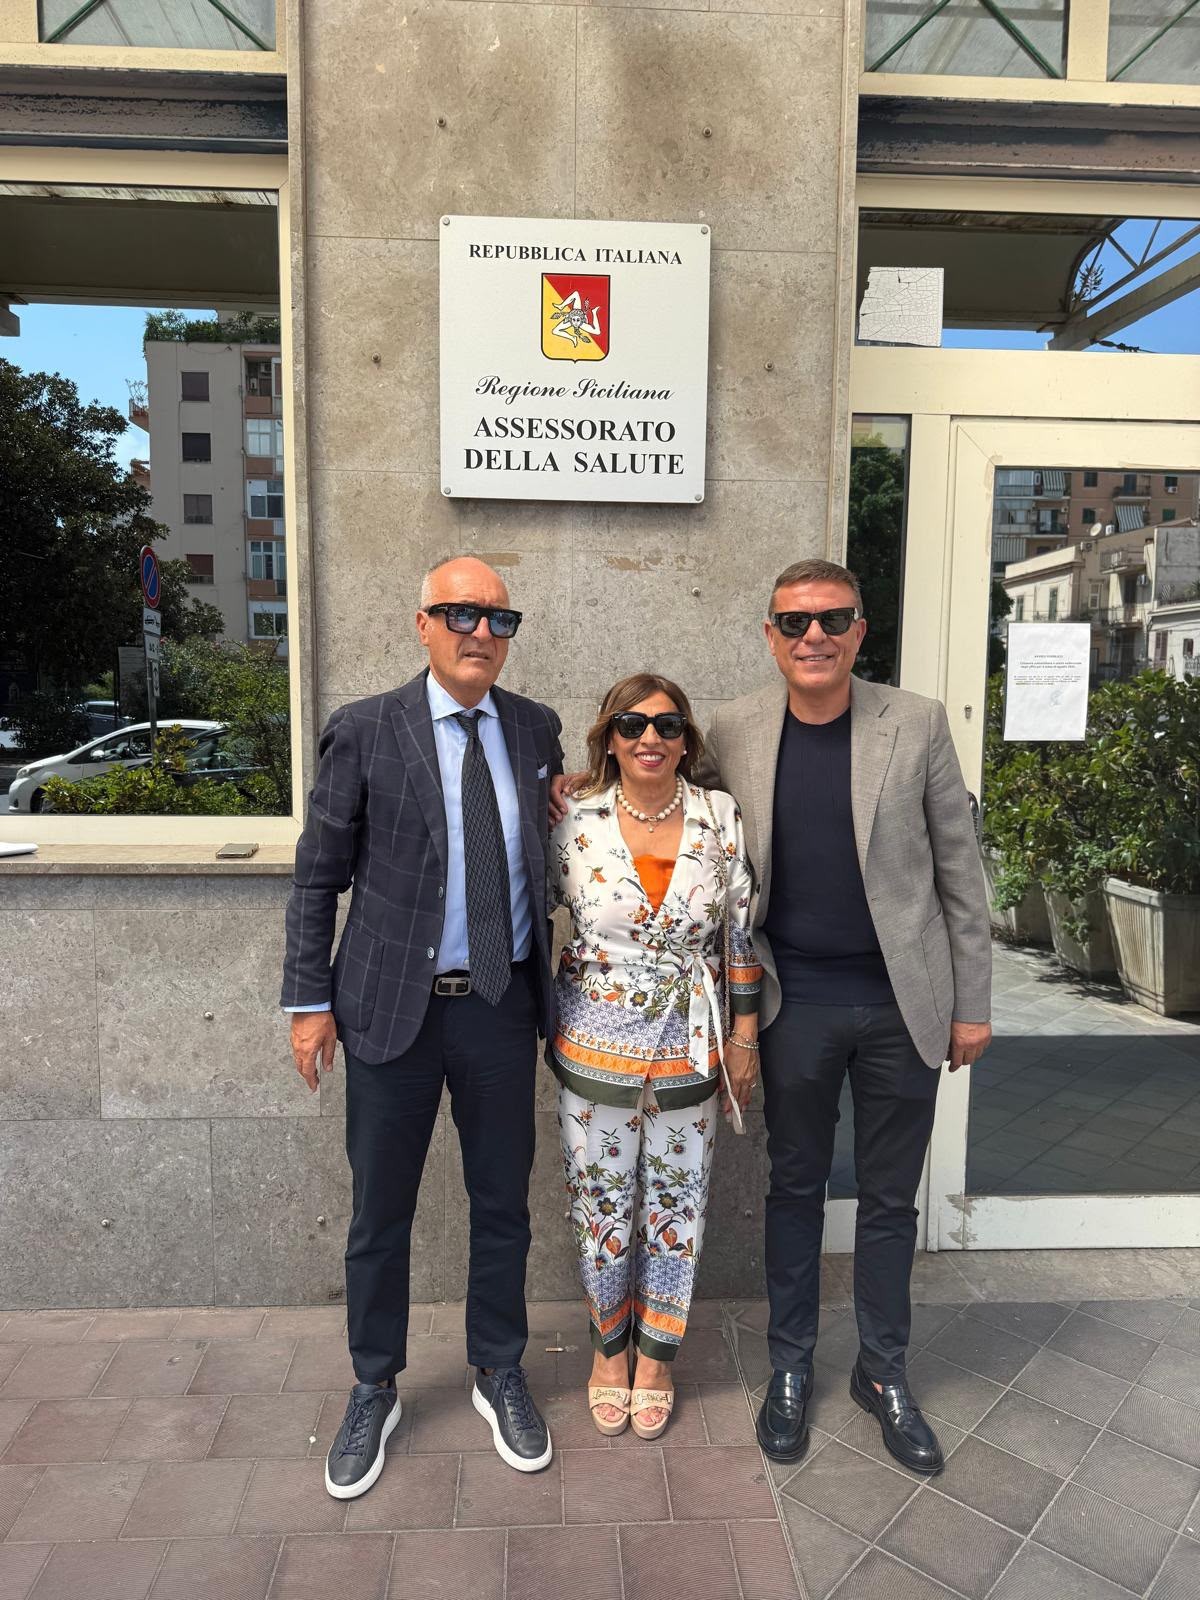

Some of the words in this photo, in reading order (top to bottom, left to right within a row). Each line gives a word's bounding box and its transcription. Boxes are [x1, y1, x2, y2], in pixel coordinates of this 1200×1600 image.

[469, 244, 587, 262] REPUBBLICA
[596, 248, 683, 265] ITALIANA
[475, 375, 567, 405] Regione
[572, 377, 675, 401] Siciliana
[473, 416, 676, 443] ASSESSORATO
[464, 448, 560, 472] DELLA
[573, 452, 684, 475] SALUTE
